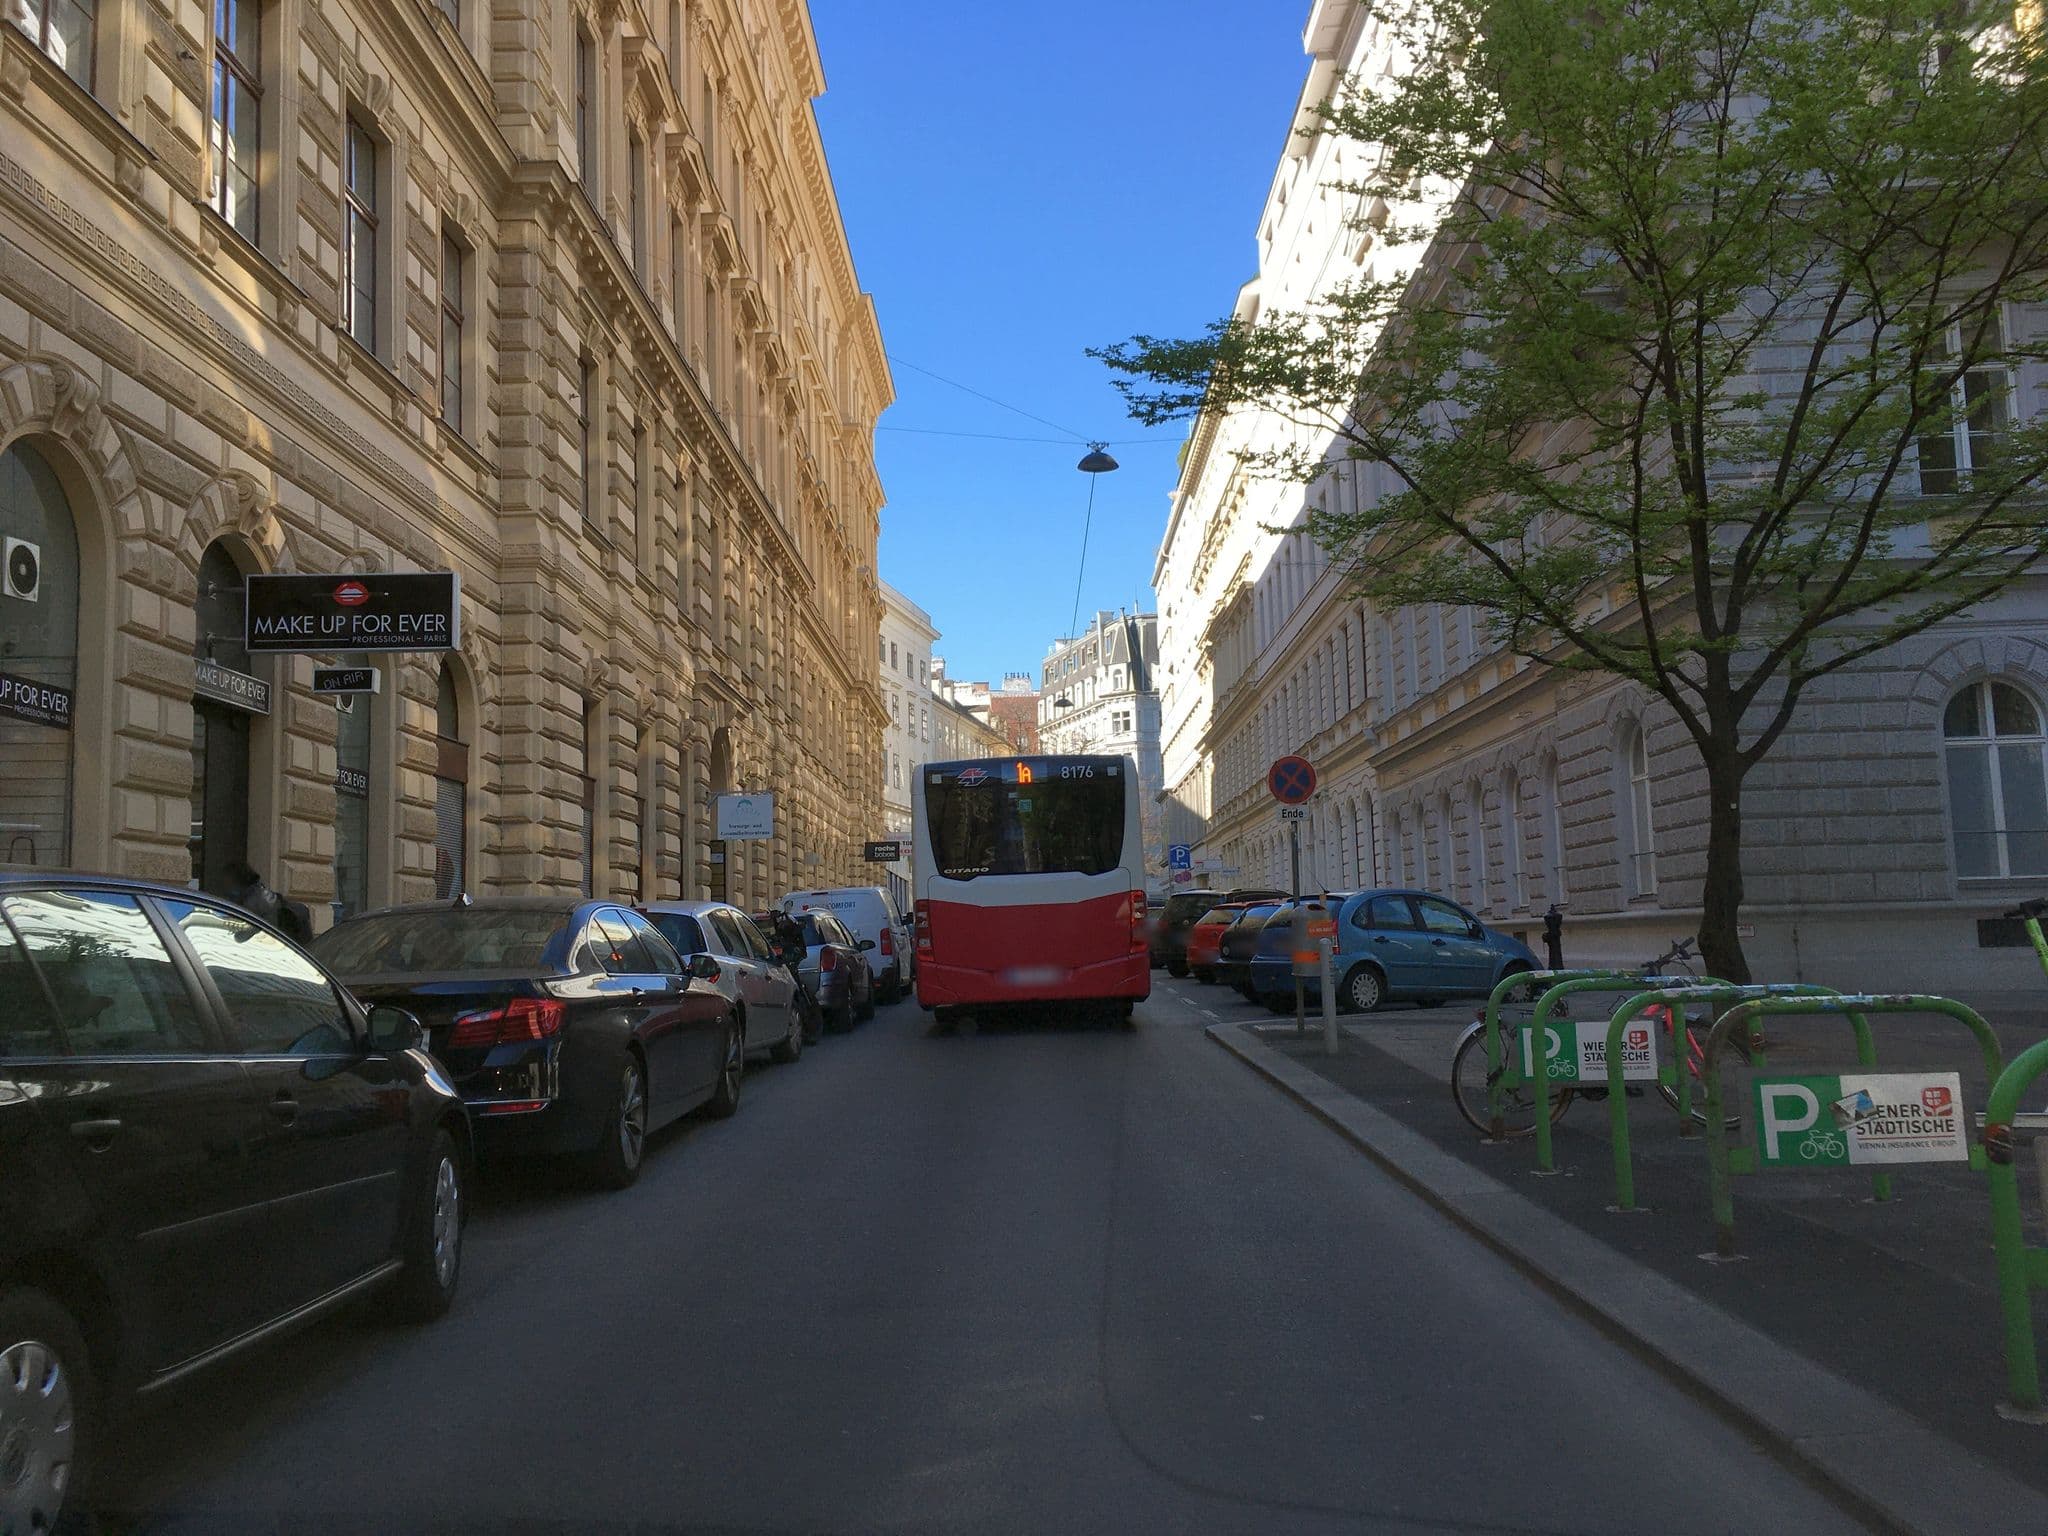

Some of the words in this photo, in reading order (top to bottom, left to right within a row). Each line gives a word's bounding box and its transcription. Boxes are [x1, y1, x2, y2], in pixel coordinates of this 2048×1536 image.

[254, 615, 314, 635] MAKE
[321, 615, 346, 634] UP
[352, 614, 391, 633] FOR
[399, 614, 446, 632] EVER
[352, 634, 415, 644] PROFESSIONAL
[423, 634, 447, 642] PARIS
[194, 665, 218, 686] MAKE
[219, 671, 231, 689] UP
[231, 676, 247, 696] FOR
[247, 681, 266, 702] EVER
[15, 682, 38, 707] FOR
[41, 689, 69, 714] EVER
[1016, 761, 1032, 785] 1A
[1060, 765, 1094, 779] 8176
[1281, 808, 1304, 819] Ende
[1176, 849, 1186, 862] P
[943, 866, 990, 875] CITARO
[1583, 1041, 1628, 1052] WIER
[1584, 1051, 1650, 1062] STÄSCHE
[1876, 1103, 1922, 1119] ENER
[1760, 1083, 1819, 1160] P
[1856, 1119, 1956, 1136] STÄDTISCHE
